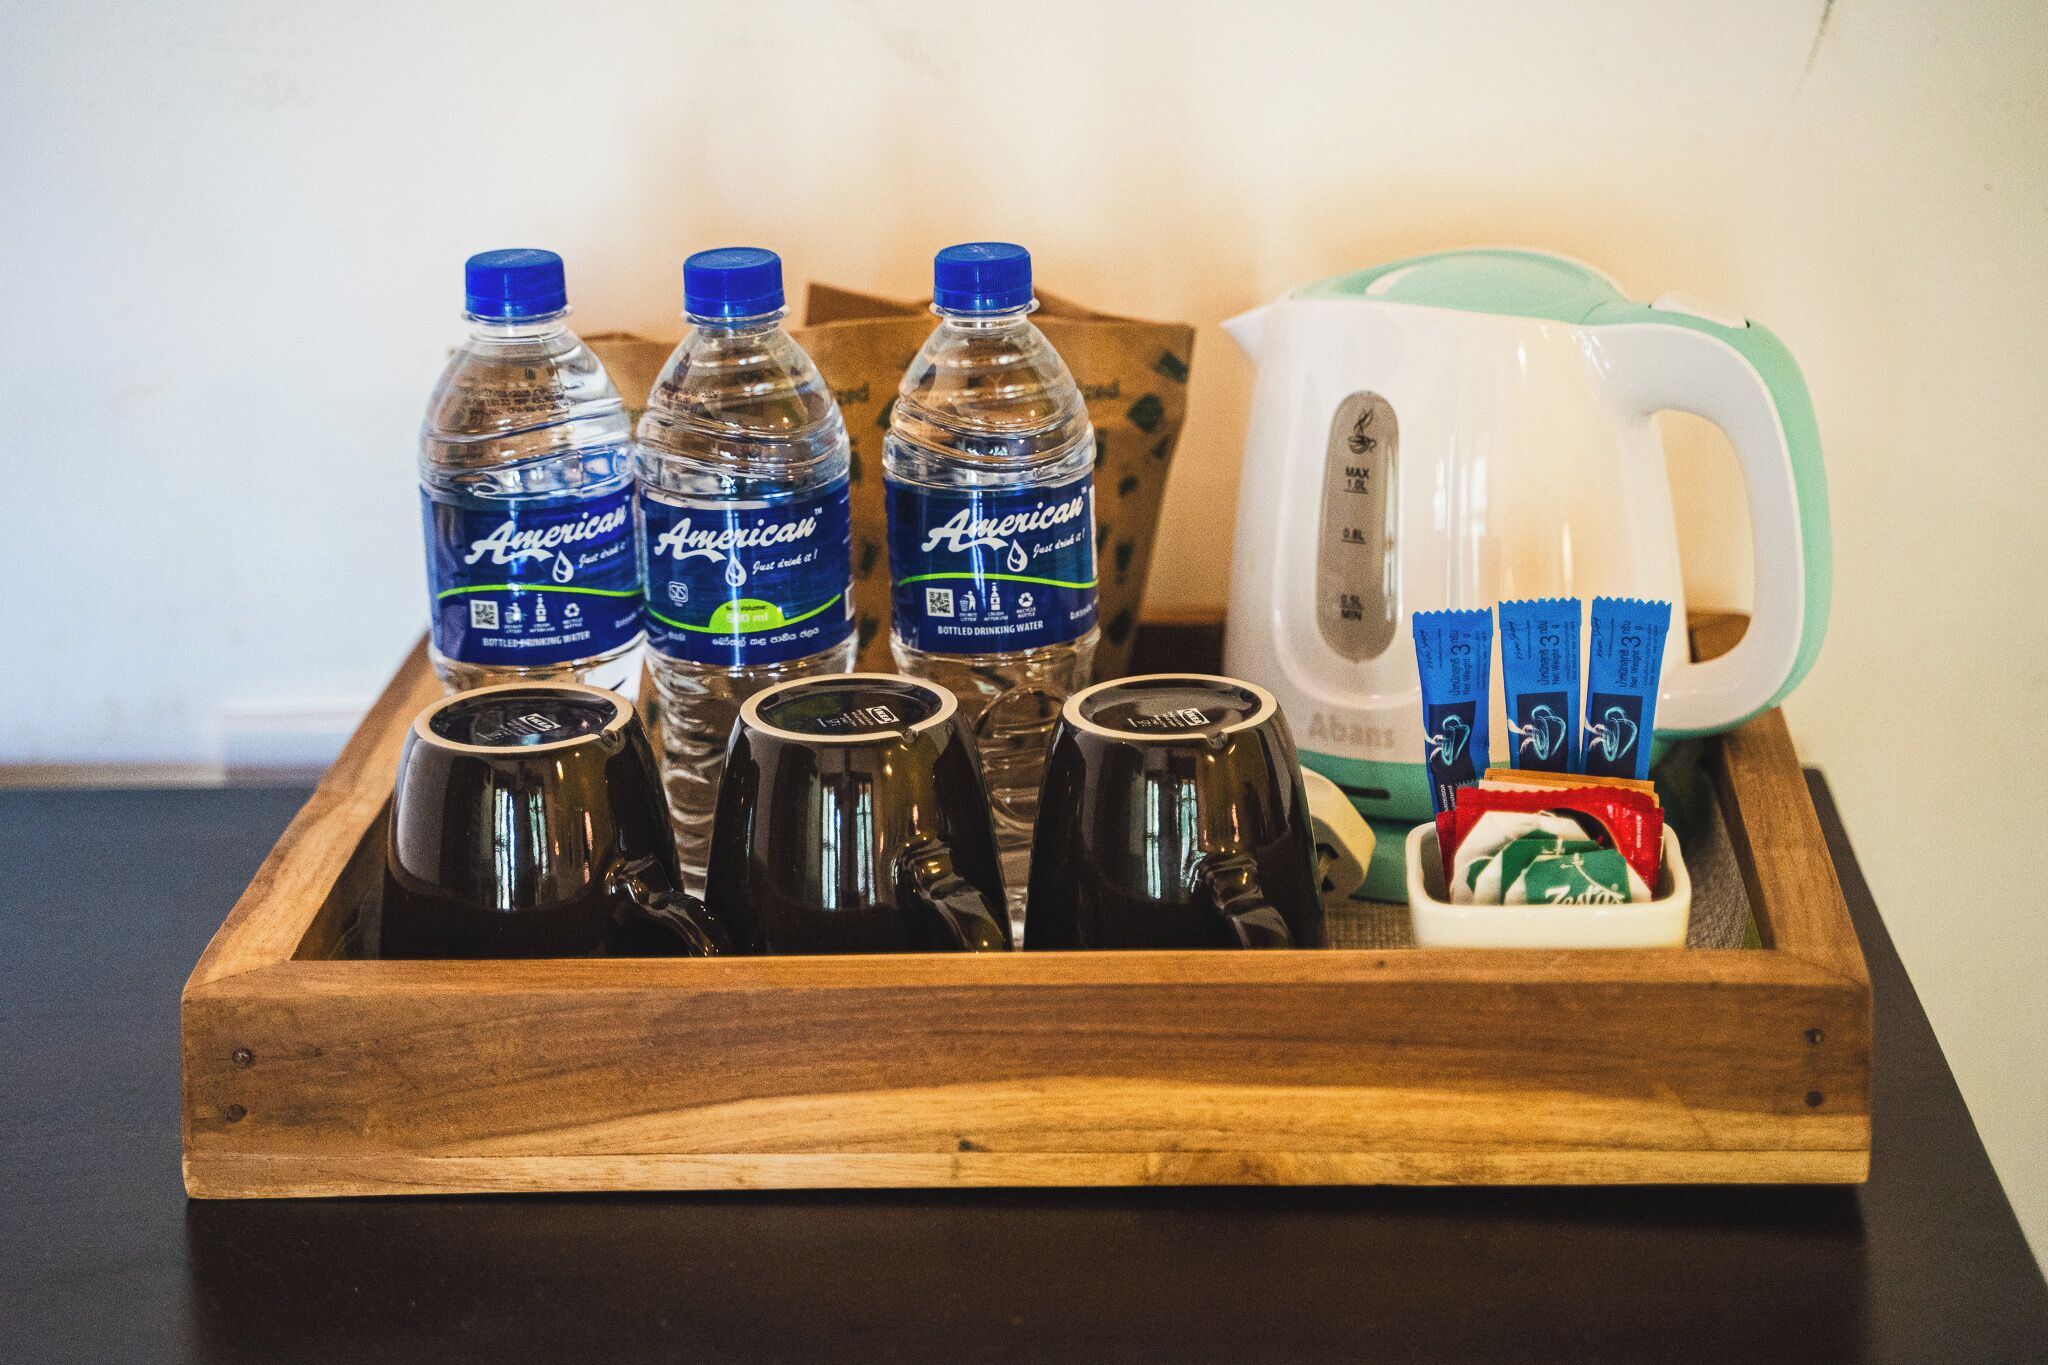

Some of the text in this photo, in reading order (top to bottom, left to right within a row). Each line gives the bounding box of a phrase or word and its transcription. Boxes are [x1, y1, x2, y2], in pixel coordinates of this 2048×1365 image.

[1345, 467, 1369, 479] MAX
[921, 495, 1084, 552] American
[464, 504, 628, 565] American
[654, 516, 817, 563] American
[1032, 543, 1054, 559] Just
[1055, 533, 1075, 549] drink
[752, 560, 775, 575] Just
[777, 554, 802, 568] drink
[937, 620, 1044, 636] BOTTLED DRINKING WATER
[483, 638, 517, 648] BOTTLED
[562, 630, 591, 643] WATER
[1540, 634, 1560, 646] 3
[1621, 636, 1641, 647] 3
[1451, 644, 1471, 656] 3
[1552, 649, 1561, 671] Weight
[1630, 650, 1640, 674] Weight
[1462, 658, 1472, 681] Weight
[1552, 673, 1560, 685] Net
[1630, 676, 1638, 688] Net
[1462, 684, 1471, 695] Net
